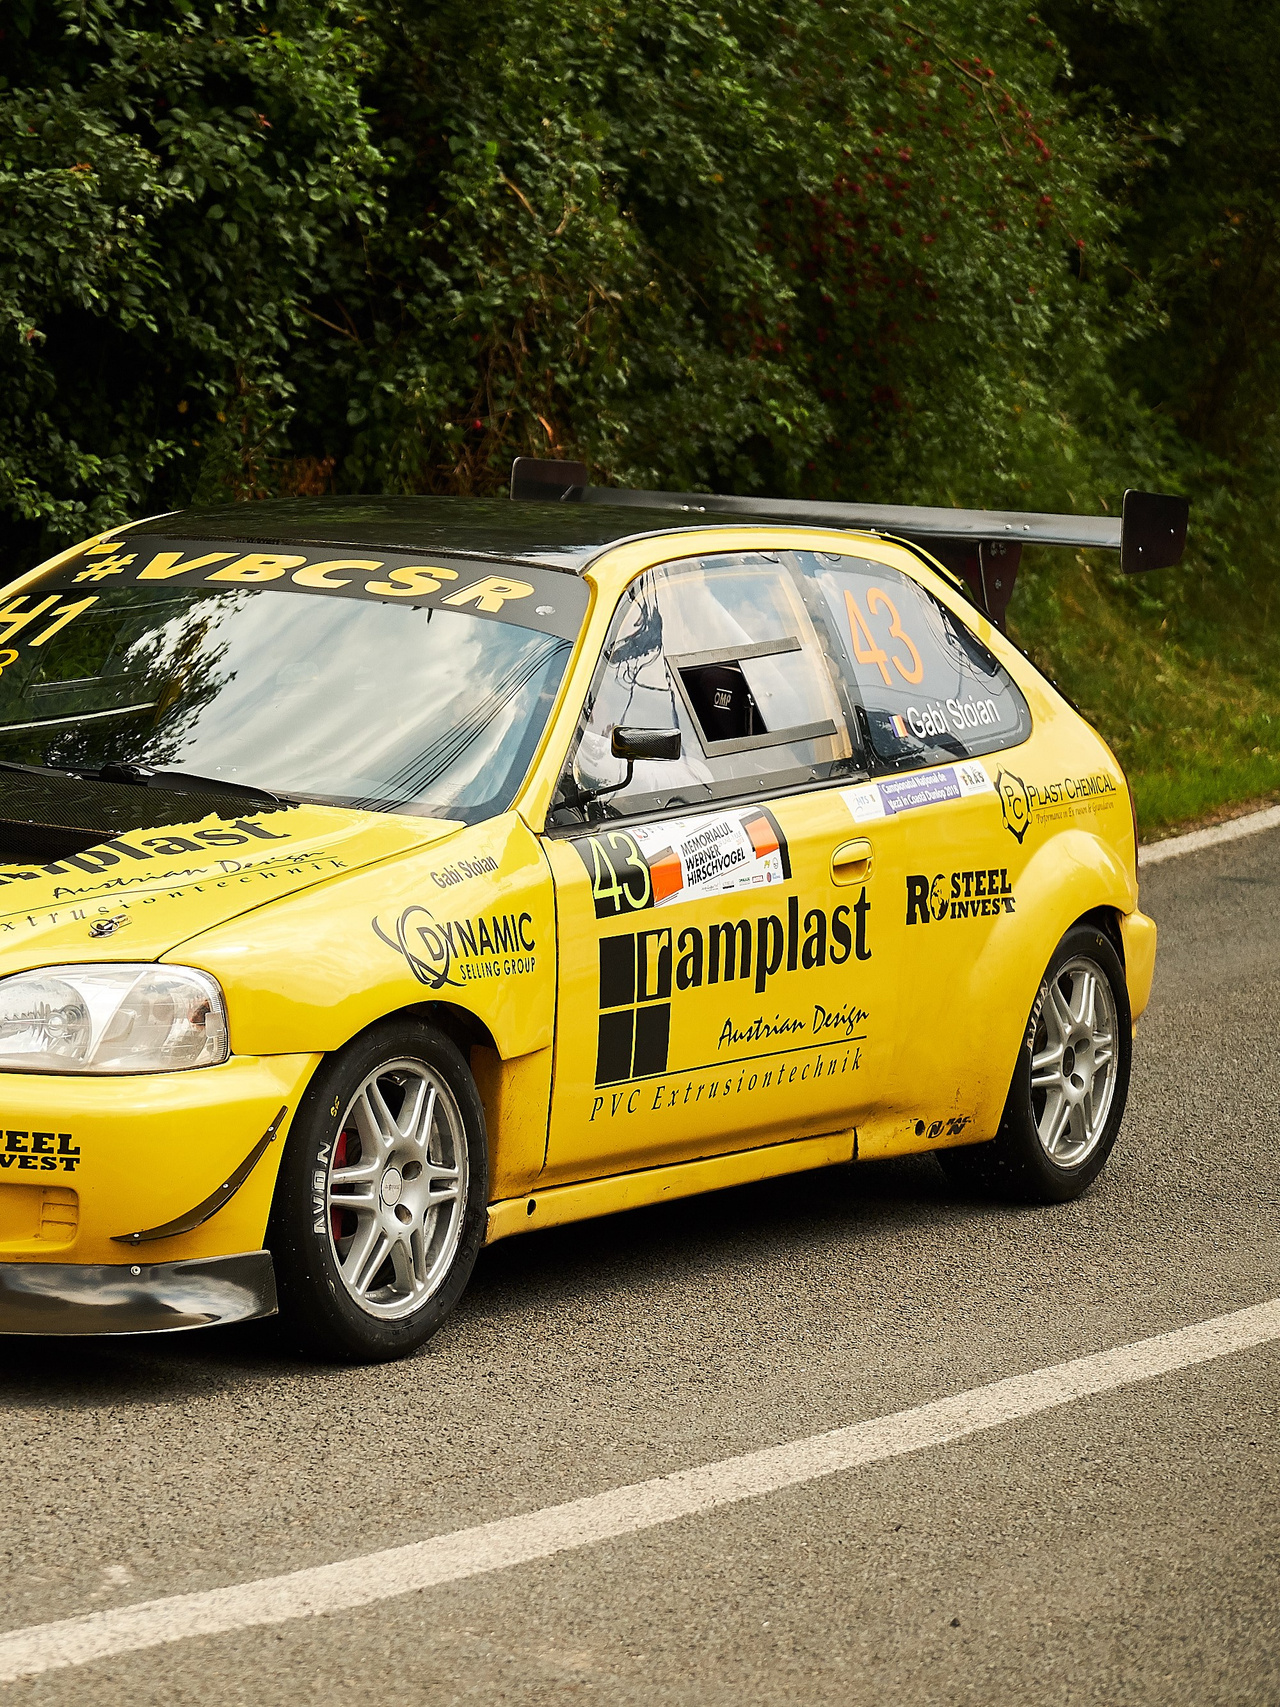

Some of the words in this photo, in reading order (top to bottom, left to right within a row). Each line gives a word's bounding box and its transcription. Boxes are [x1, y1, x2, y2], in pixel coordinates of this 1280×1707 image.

[71, 552, 535, 613] #VBCSR
[843, 587, 924, 686] 43
[714, 691, 732, 706] OMP
[906, 702, 951, 739] Gabi
[946, 695, 1001, 730] Stoian
[881, 776, 918, 795] Campionatul
[925, 787, 947, 800] Dunlop
[944, 784, 960, 797] 2018
[1026, 783, 1063, 807] PLAST
[1064, 774, 1116, 799] CHEMICAL
[680, 822, 733, 857] MEMORIALUL
[685, 844, 722, 871] WERNER
[53, 867, 208, 899] Austrian
[214, 851, 325, 873] Design
[430, 864, 464, 889] Gabi
[458, 855, 499, 879] Stoian
[586, 831, 651, 911] 43
[687, 847, 746, 887] HIRSCHVOGEL
[950, 868, 1012, 899] STEEL
[950, 896, 1016, 919] INVEST
[416, 912, 536, 961] DYNAMIC
[645, 886, 872, 998] ramplast
[459, 960, 501, 981] SELLING
[503, 956, 536, 976] GROUP
[717, 1013, 806, 1050] Austrian
[812, 1003, 870, 1036] Design
[588, 1088, 641, 1122] PVC
[651, 1046, 863, 1111] Extrusiontechnik
[312, 1141, 332, 1235] AVON
